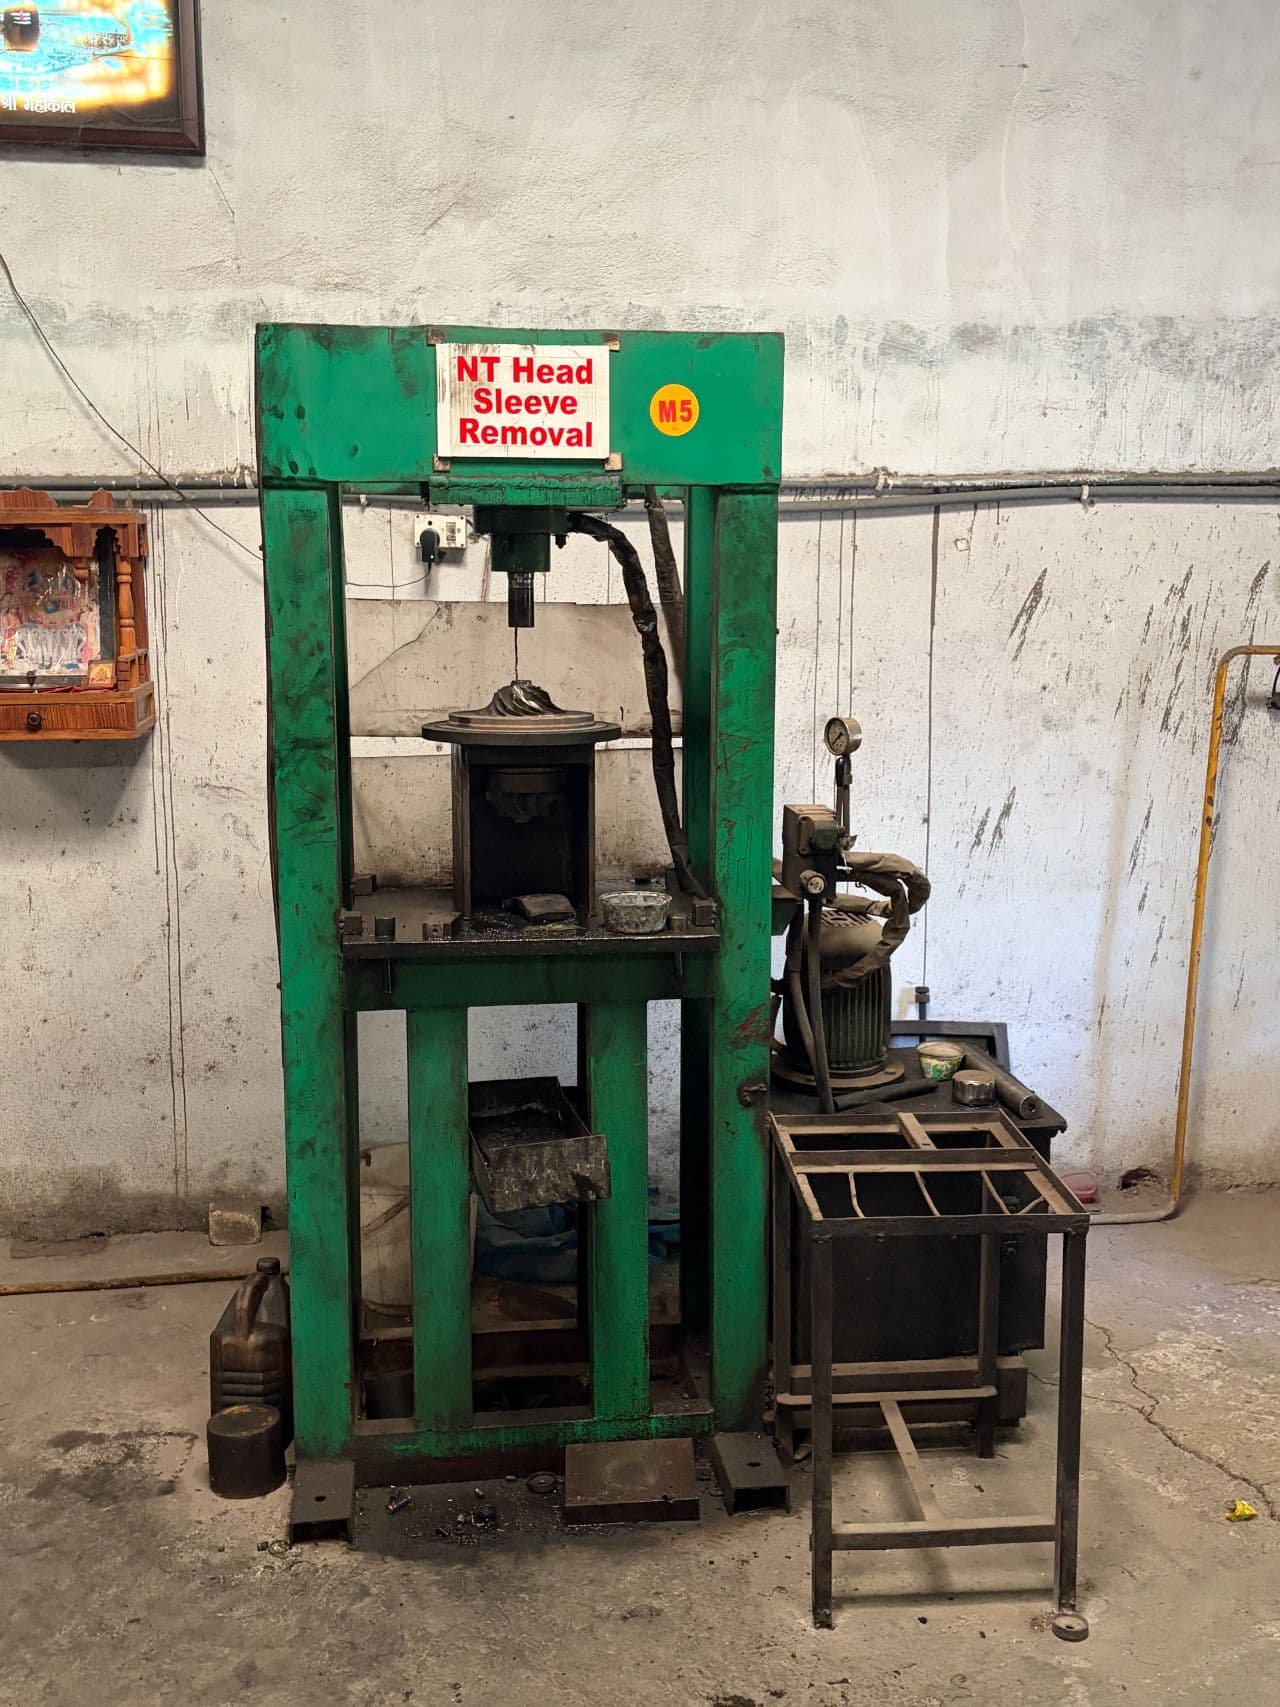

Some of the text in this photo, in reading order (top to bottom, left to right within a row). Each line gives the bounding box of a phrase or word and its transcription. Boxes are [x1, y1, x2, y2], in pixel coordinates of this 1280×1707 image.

[457, 356, 593, 384] NT Head
[474, 388, 578, 414] Sleeve
[659, 400, 693, 422] M5
[459, 418, 593, 447] Removal
